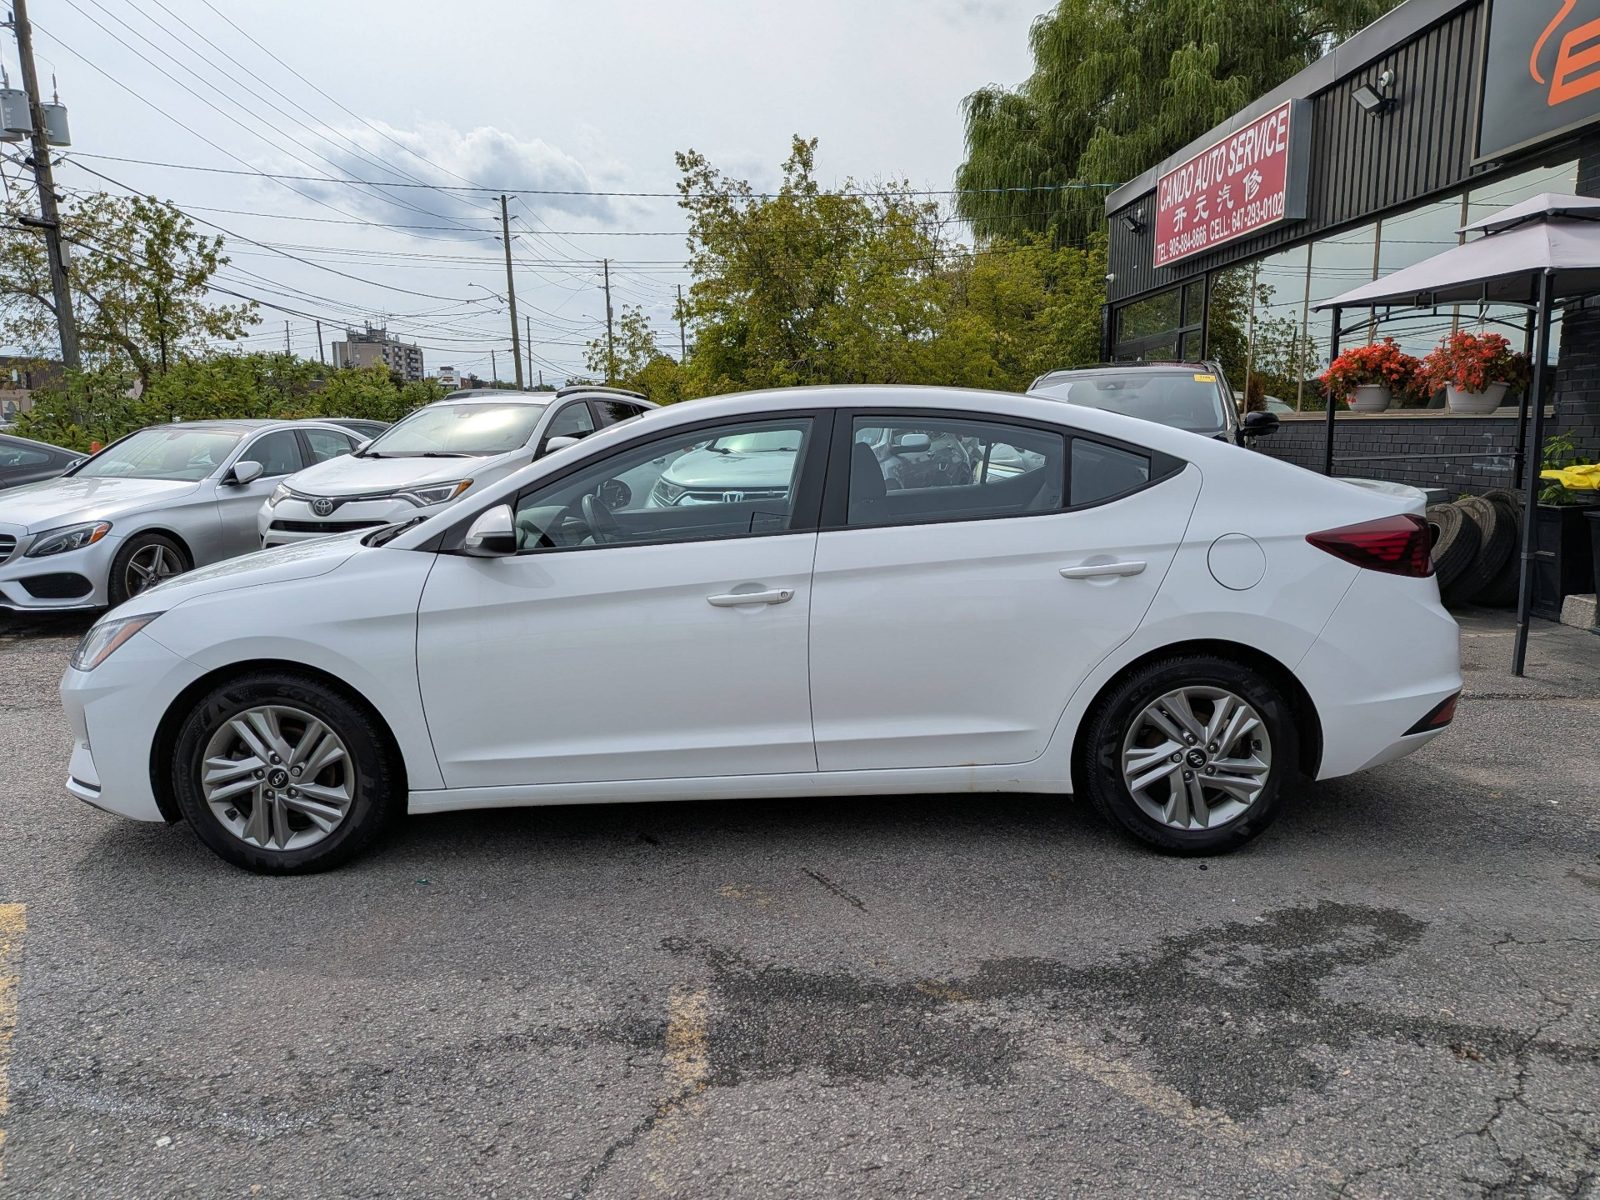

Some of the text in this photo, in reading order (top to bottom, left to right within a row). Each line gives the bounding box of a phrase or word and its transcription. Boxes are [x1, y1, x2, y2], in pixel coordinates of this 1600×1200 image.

[1160, 109, 1288, 213] CANDO AUTO SERVICE
[1157, 244, 1168, 262] TEL:
[1210, 219, 1230, 241] CELL:
[1231, 194, 1284, 232] 647-293-0102
[1173, 168, 1262, 232] 开元汽修
